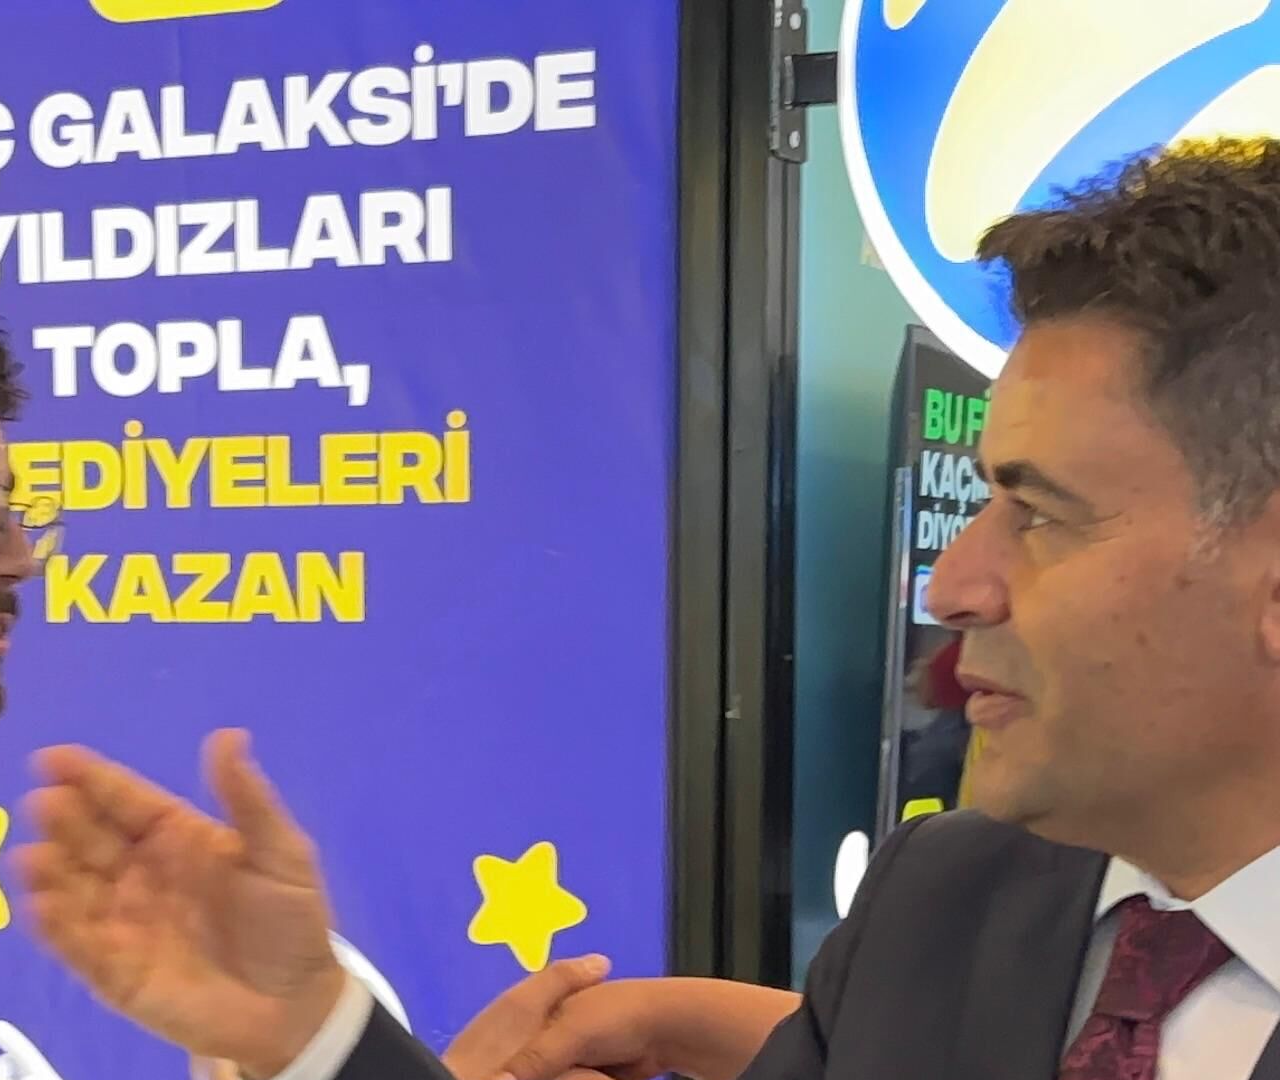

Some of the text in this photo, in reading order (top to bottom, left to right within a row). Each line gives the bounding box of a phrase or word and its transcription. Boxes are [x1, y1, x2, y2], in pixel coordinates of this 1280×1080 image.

[32, 314, 370, 406] TOPLA,
[923, 387, 965, 445] BU
[7, 410, 471, 512] EDİYELERİ
[45, 551, 366, 625] KAZAN
